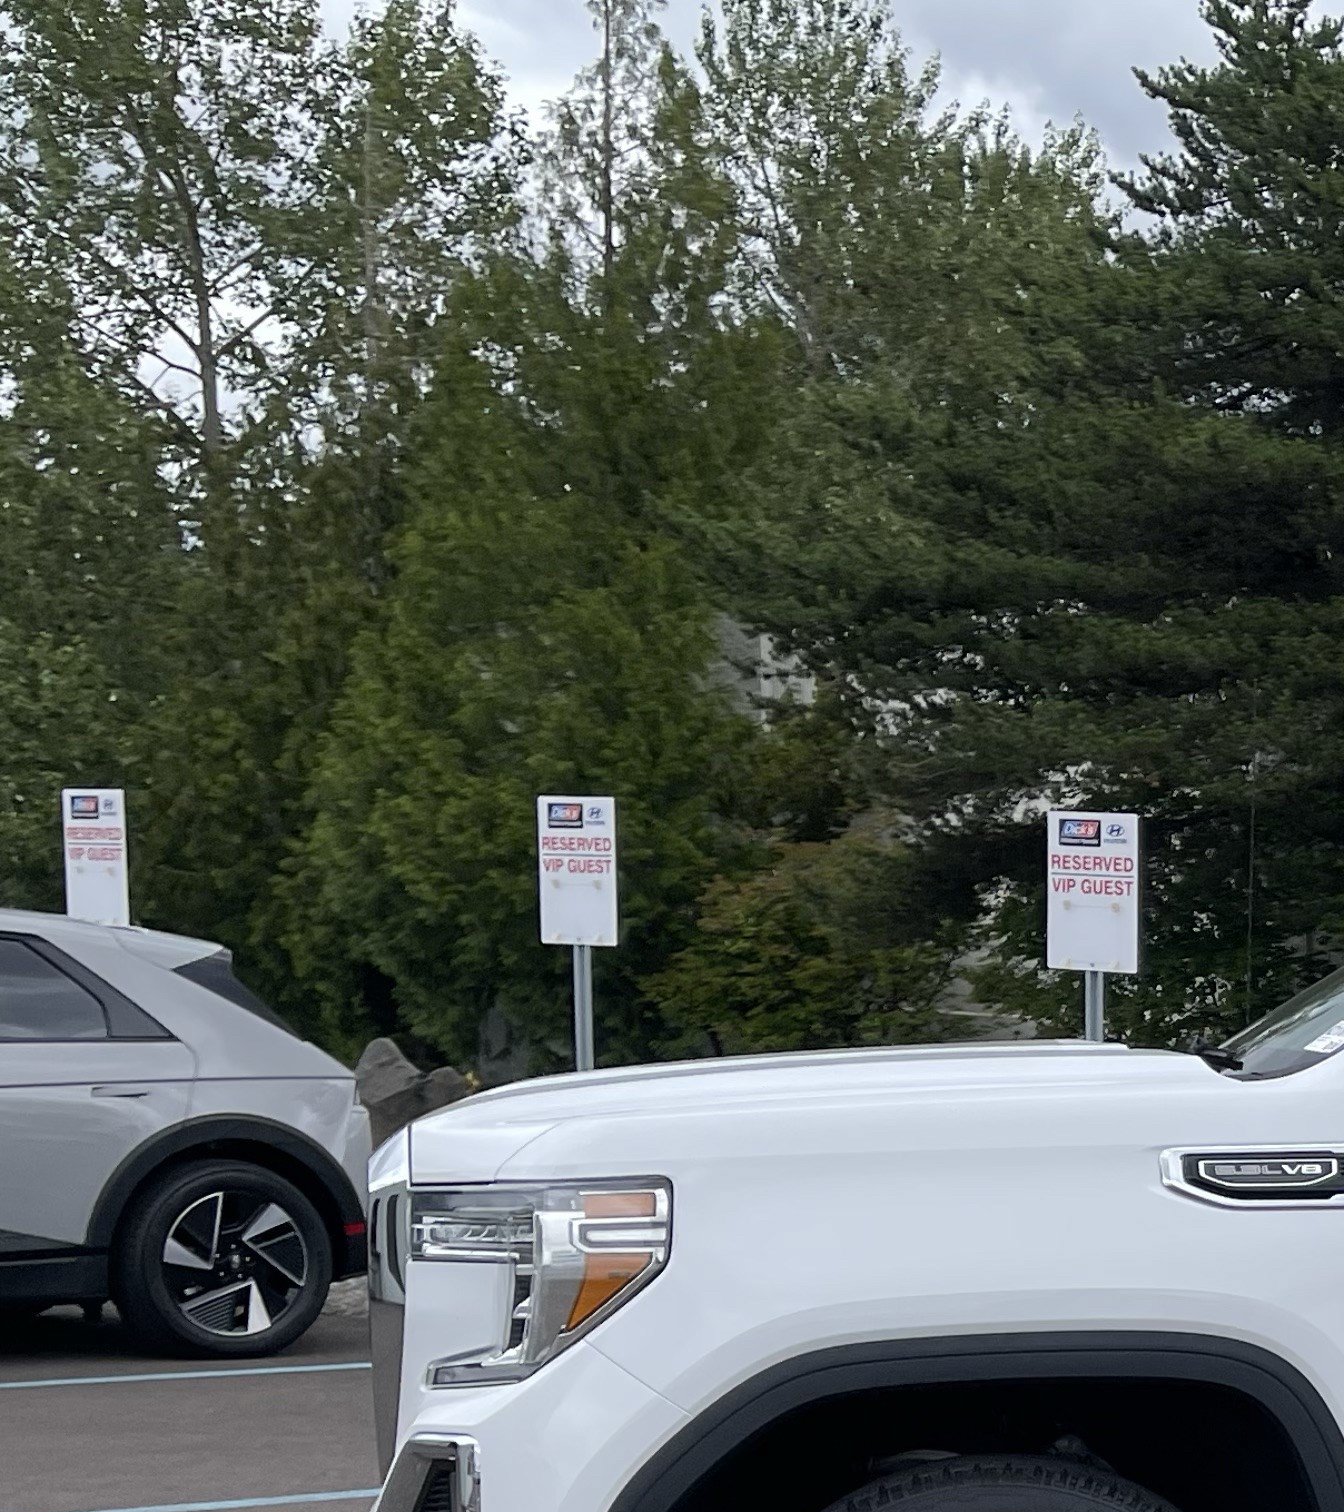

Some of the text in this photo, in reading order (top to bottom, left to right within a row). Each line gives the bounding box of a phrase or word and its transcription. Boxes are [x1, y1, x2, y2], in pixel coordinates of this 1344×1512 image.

[542, 836, 612, 852] RESERVED
[542, 858, 612, 874] VIP GUEST
[1051, 855, 1134, 872] RESERVED
[1052, 878, 1134, 896] VIP GUEST
